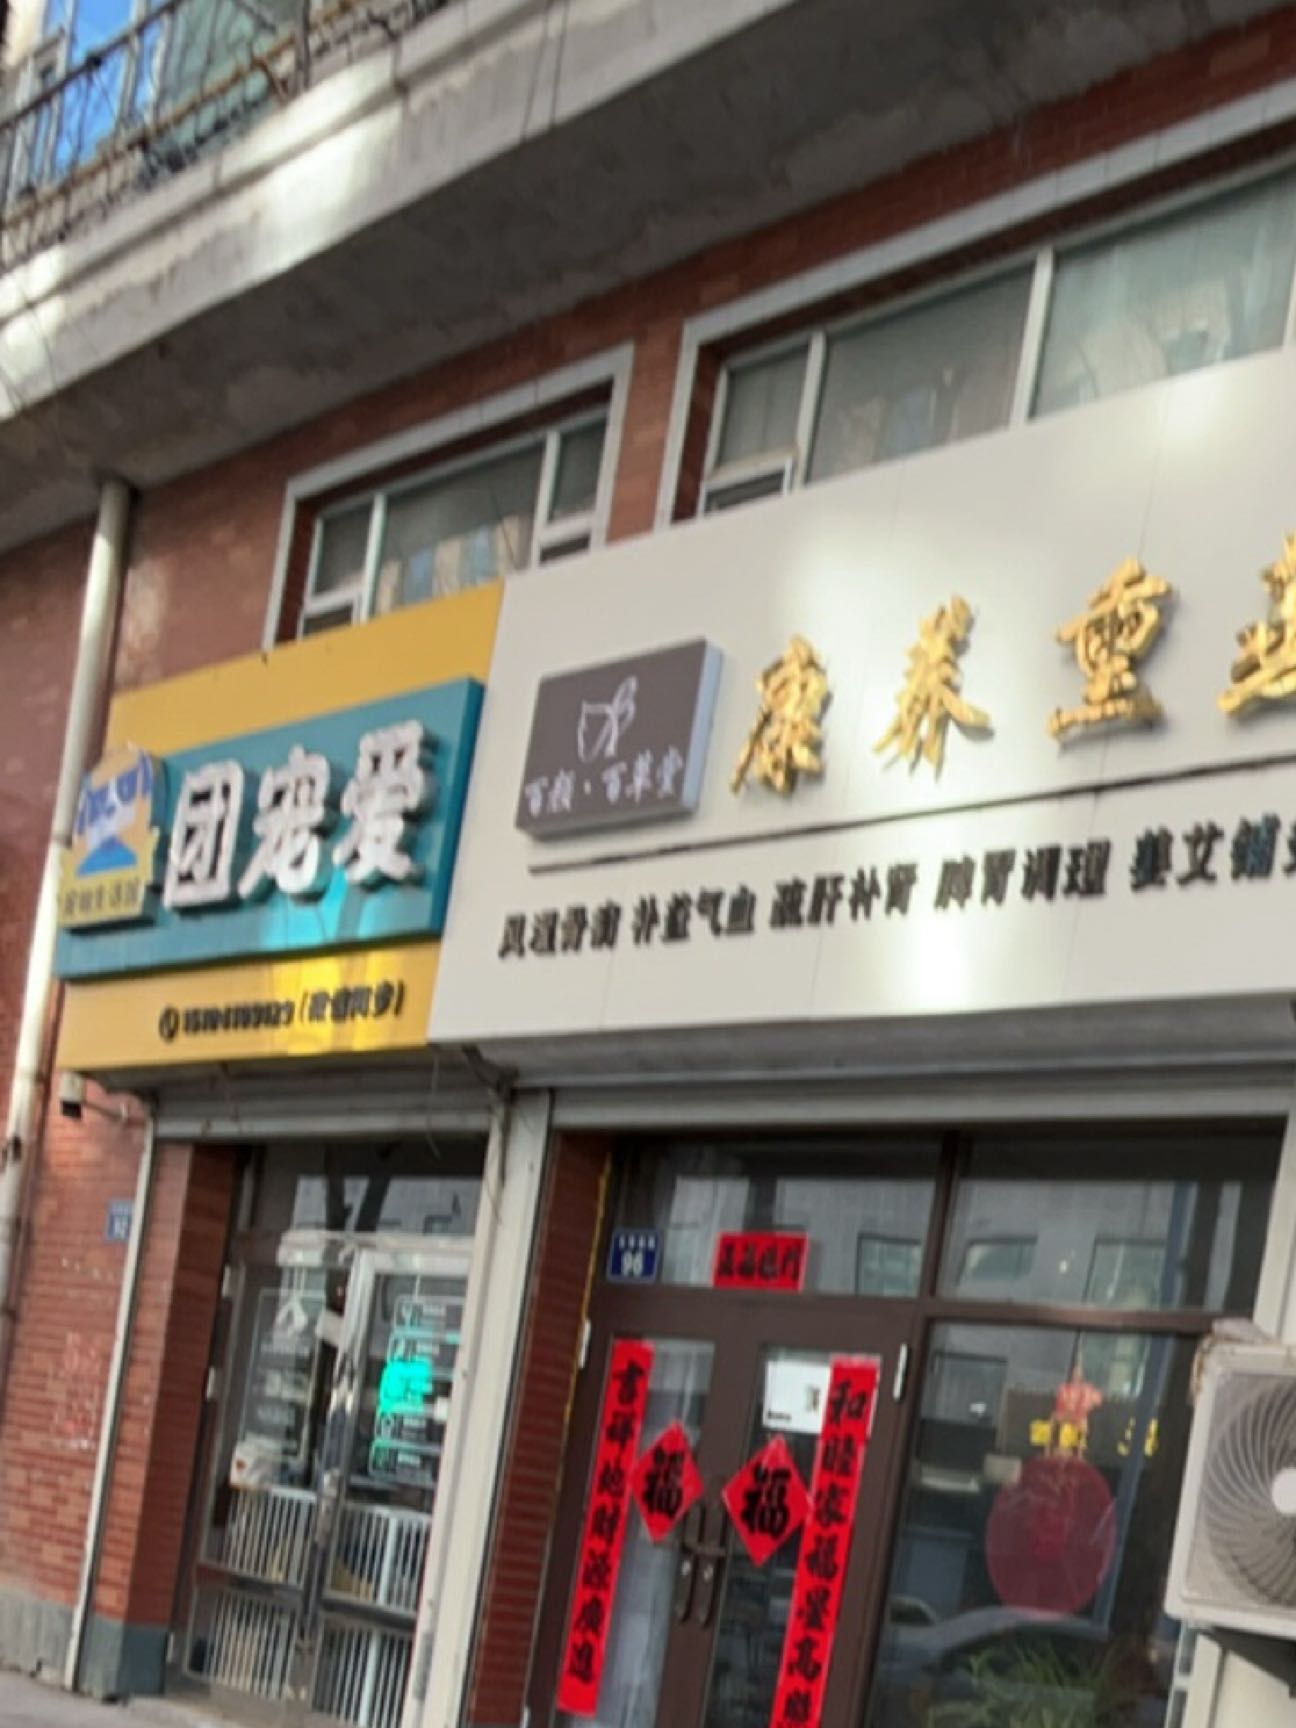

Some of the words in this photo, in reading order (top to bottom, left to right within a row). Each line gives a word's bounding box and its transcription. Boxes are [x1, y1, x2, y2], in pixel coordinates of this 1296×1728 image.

[162, 719, 427, 908] 团宠爱
[643, 1445, 685, 1519] 福
[741, 1463, 793, 1539] 福
